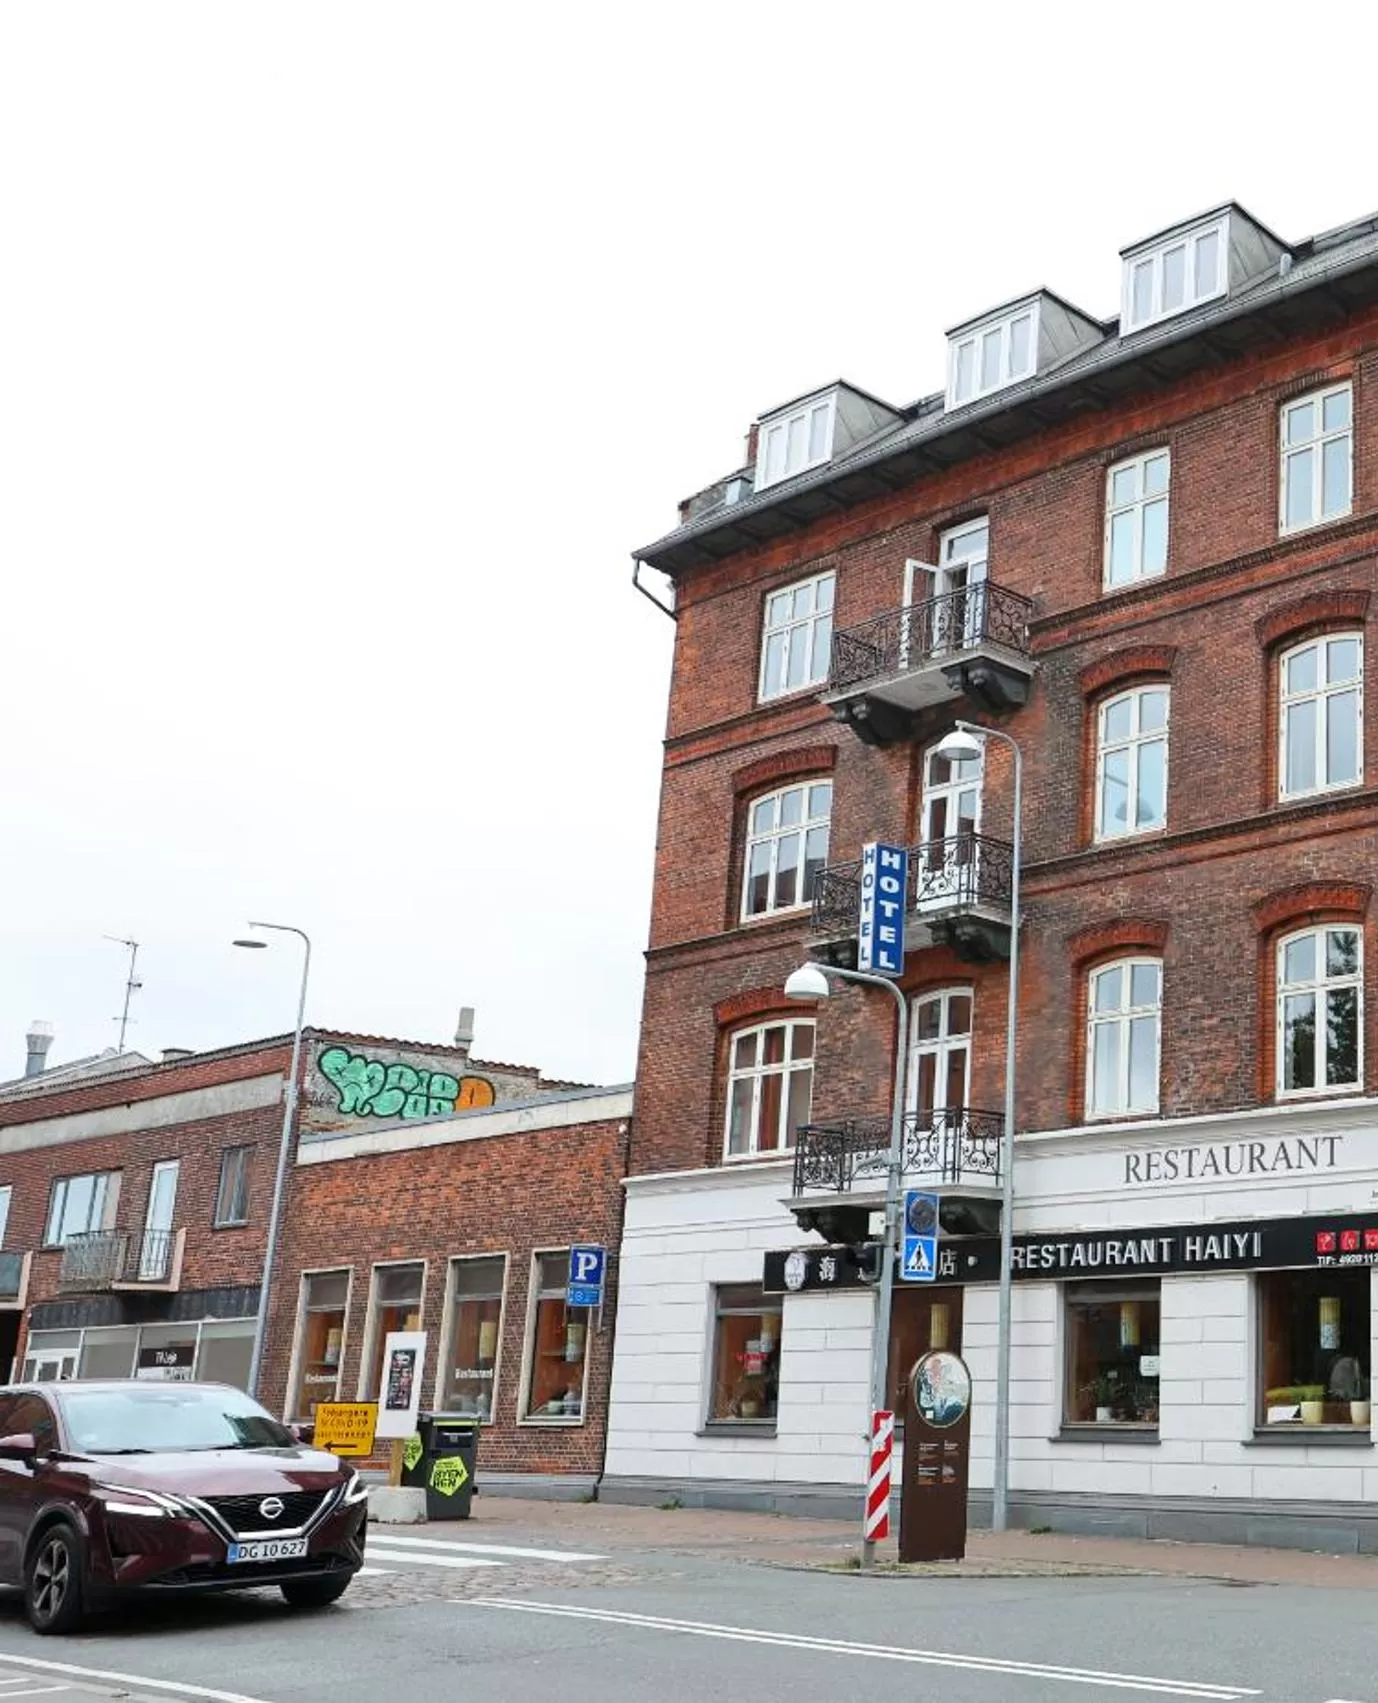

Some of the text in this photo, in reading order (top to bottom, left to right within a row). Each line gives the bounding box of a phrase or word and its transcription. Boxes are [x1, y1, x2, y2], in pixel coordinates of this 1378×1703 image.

[860, 850, 874, 962] HOTEL
[879, 851, 899, 970] HOTEL
[1125, 1136, 1343, 1184] RESTAURANT
[574, 1251, 598, 1280] P
[1010, 1231, 1262, 1270] RESTAURANT HAIYI
[238, 1545, 259, 1559] DG
